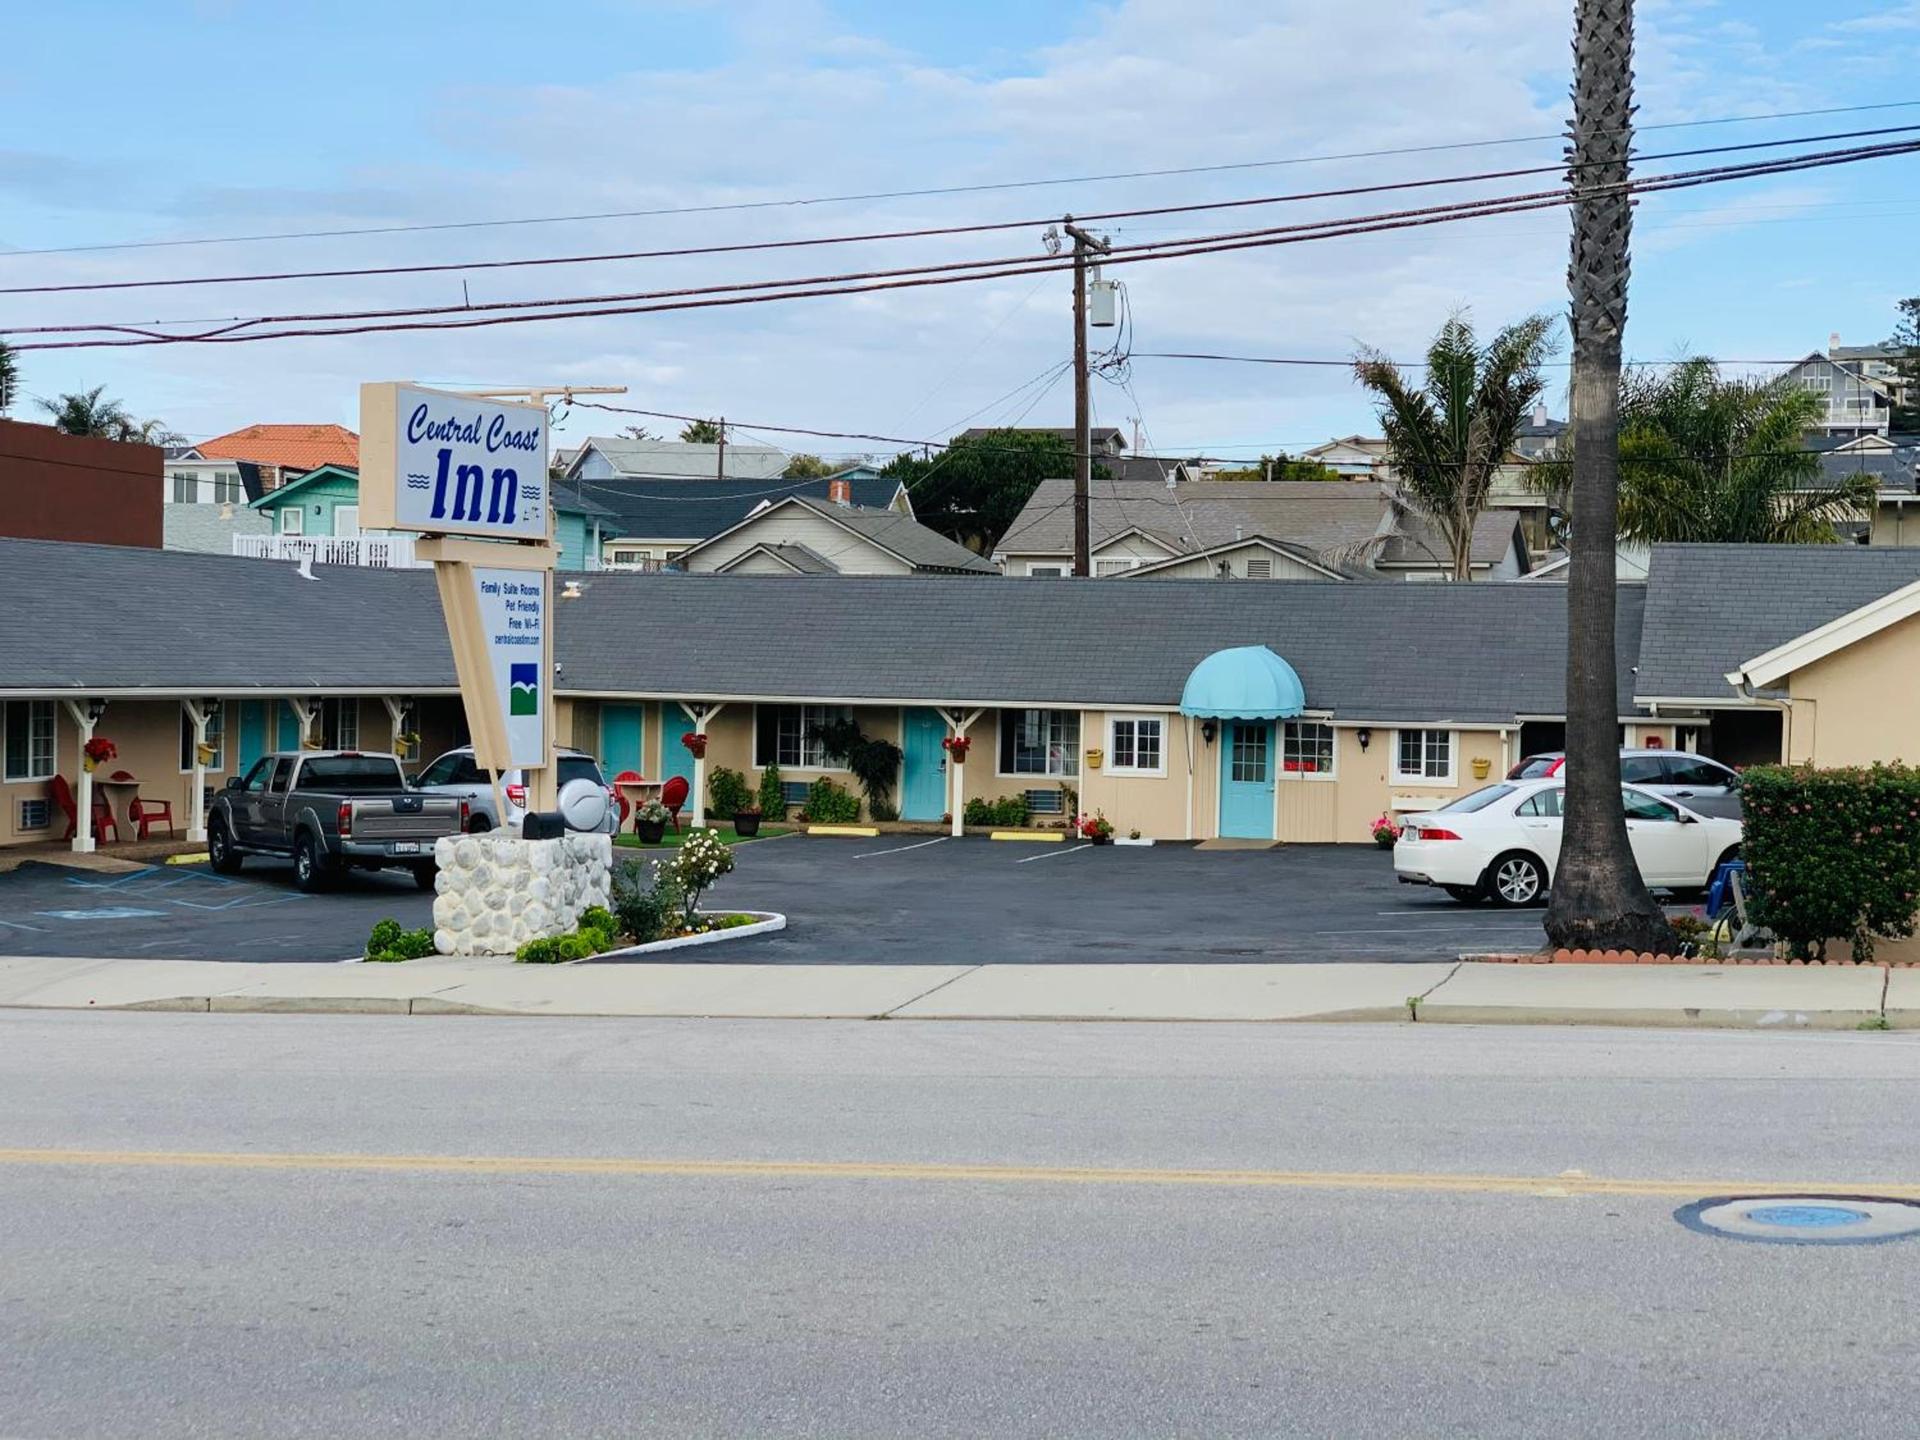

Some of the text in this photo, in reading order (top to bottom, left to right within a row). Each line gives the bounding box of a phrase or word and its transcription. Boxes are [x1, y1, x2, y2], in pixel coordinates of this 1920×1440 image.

[407, 403, 539, 452] Central Coast
[430, 448, 518, 524] Inn
[481, 581, 540, 597] Family Suite Rooms
[505, 600, 540, 615] Pet Friendly
[509, 617, 521, 629] Free
